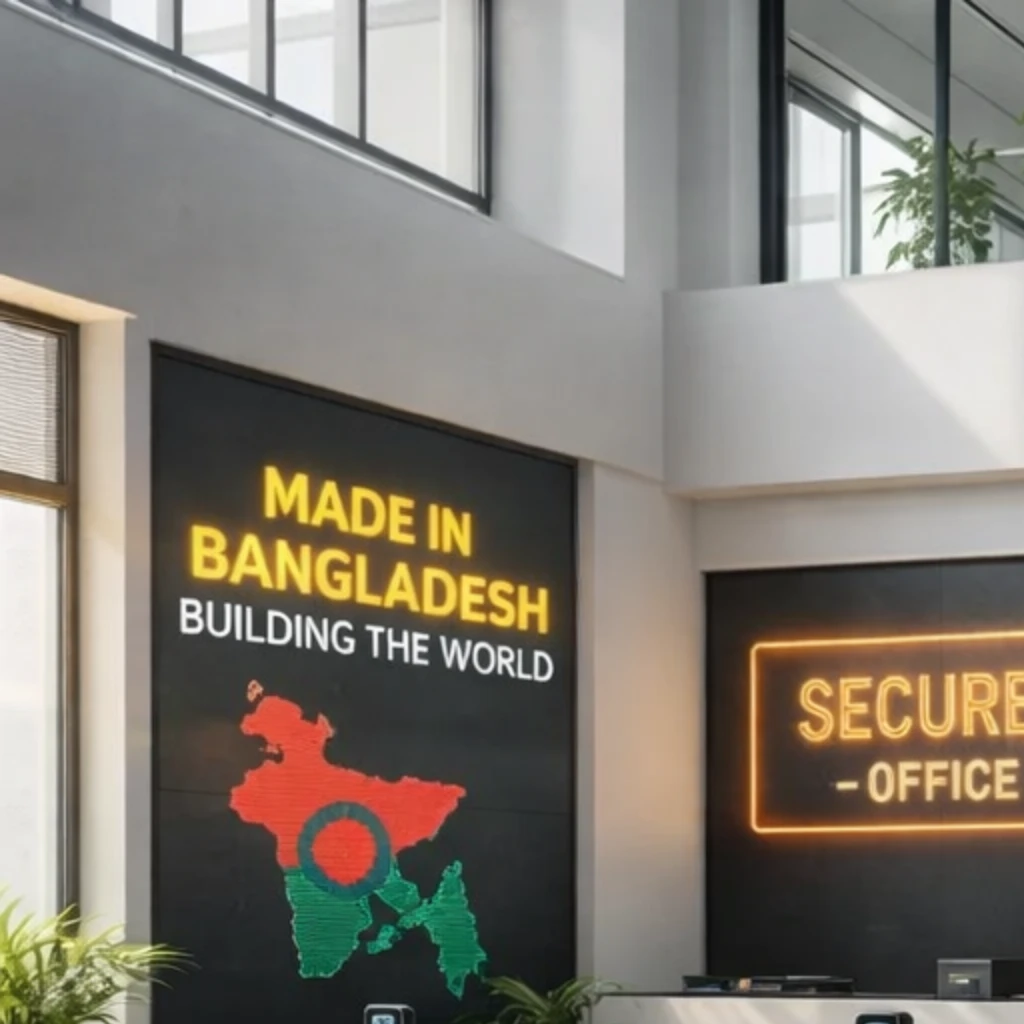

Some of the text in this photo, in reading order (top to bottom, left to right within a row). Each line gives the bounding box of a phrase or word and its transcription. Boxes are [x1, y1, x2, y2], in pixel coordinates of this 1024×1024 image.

[263, 465, 472, 557] MADE IN
[190, 524, 549, 634] BANGLADESH
[179, 597, 554, 683] BUILDING THE WORLD
[867, 758, 1020, 803] OFFICE
